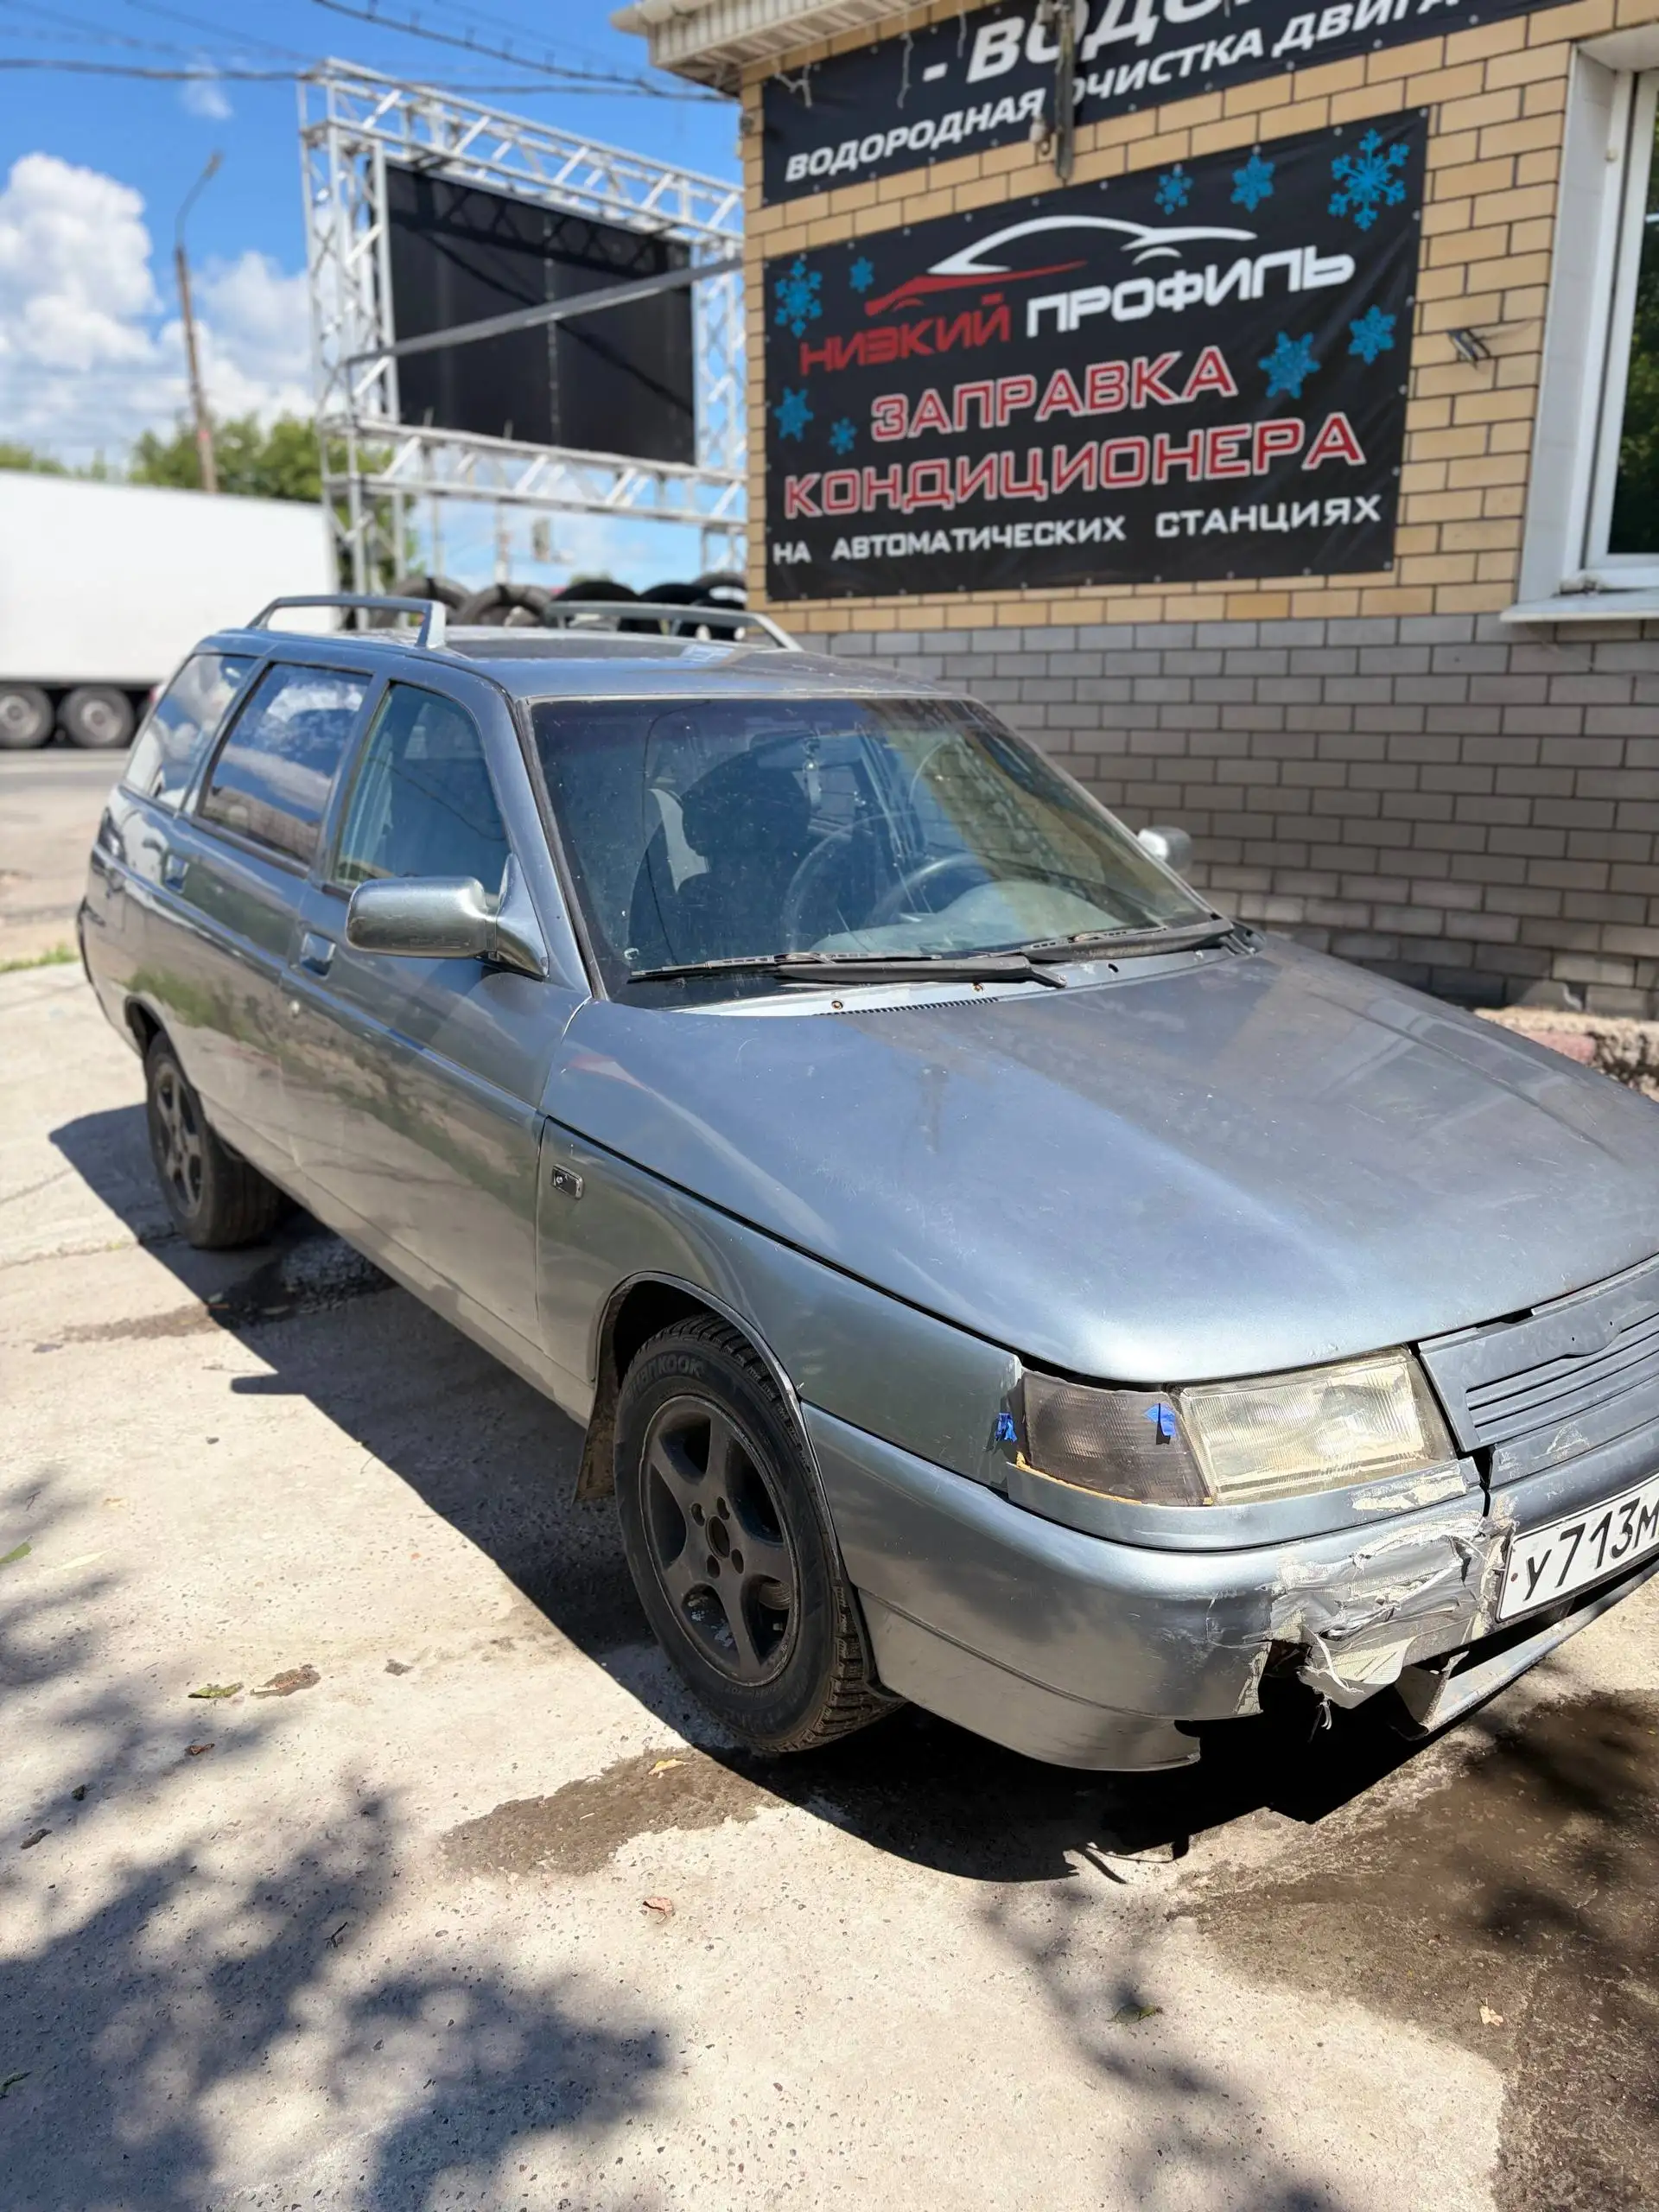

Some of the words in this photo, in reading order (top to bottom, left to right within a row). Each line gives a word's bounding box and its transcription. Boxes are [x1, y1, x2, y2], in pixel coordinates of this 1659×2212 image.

[965, 0, 1251, 84] ВОД
[785, 87, 1046, 182] ВОДОРОДНАЯ
[800, 291, 1011, 376] НИЗКИЙ
[1027, 245, 1356, 338] ПРОФИЛЬ
[871, 345, 1238, 442] ЗАПРАВКА
[784, 412, 1367, 519] КОНДИЦИОНЕРА
[772, 540, 812, 566] НА
[830, 515, 1127, 562] АВТОМАТИЧЕСКИХ
[1154, 493, 1382, 539] СТАНЦИЯХ
